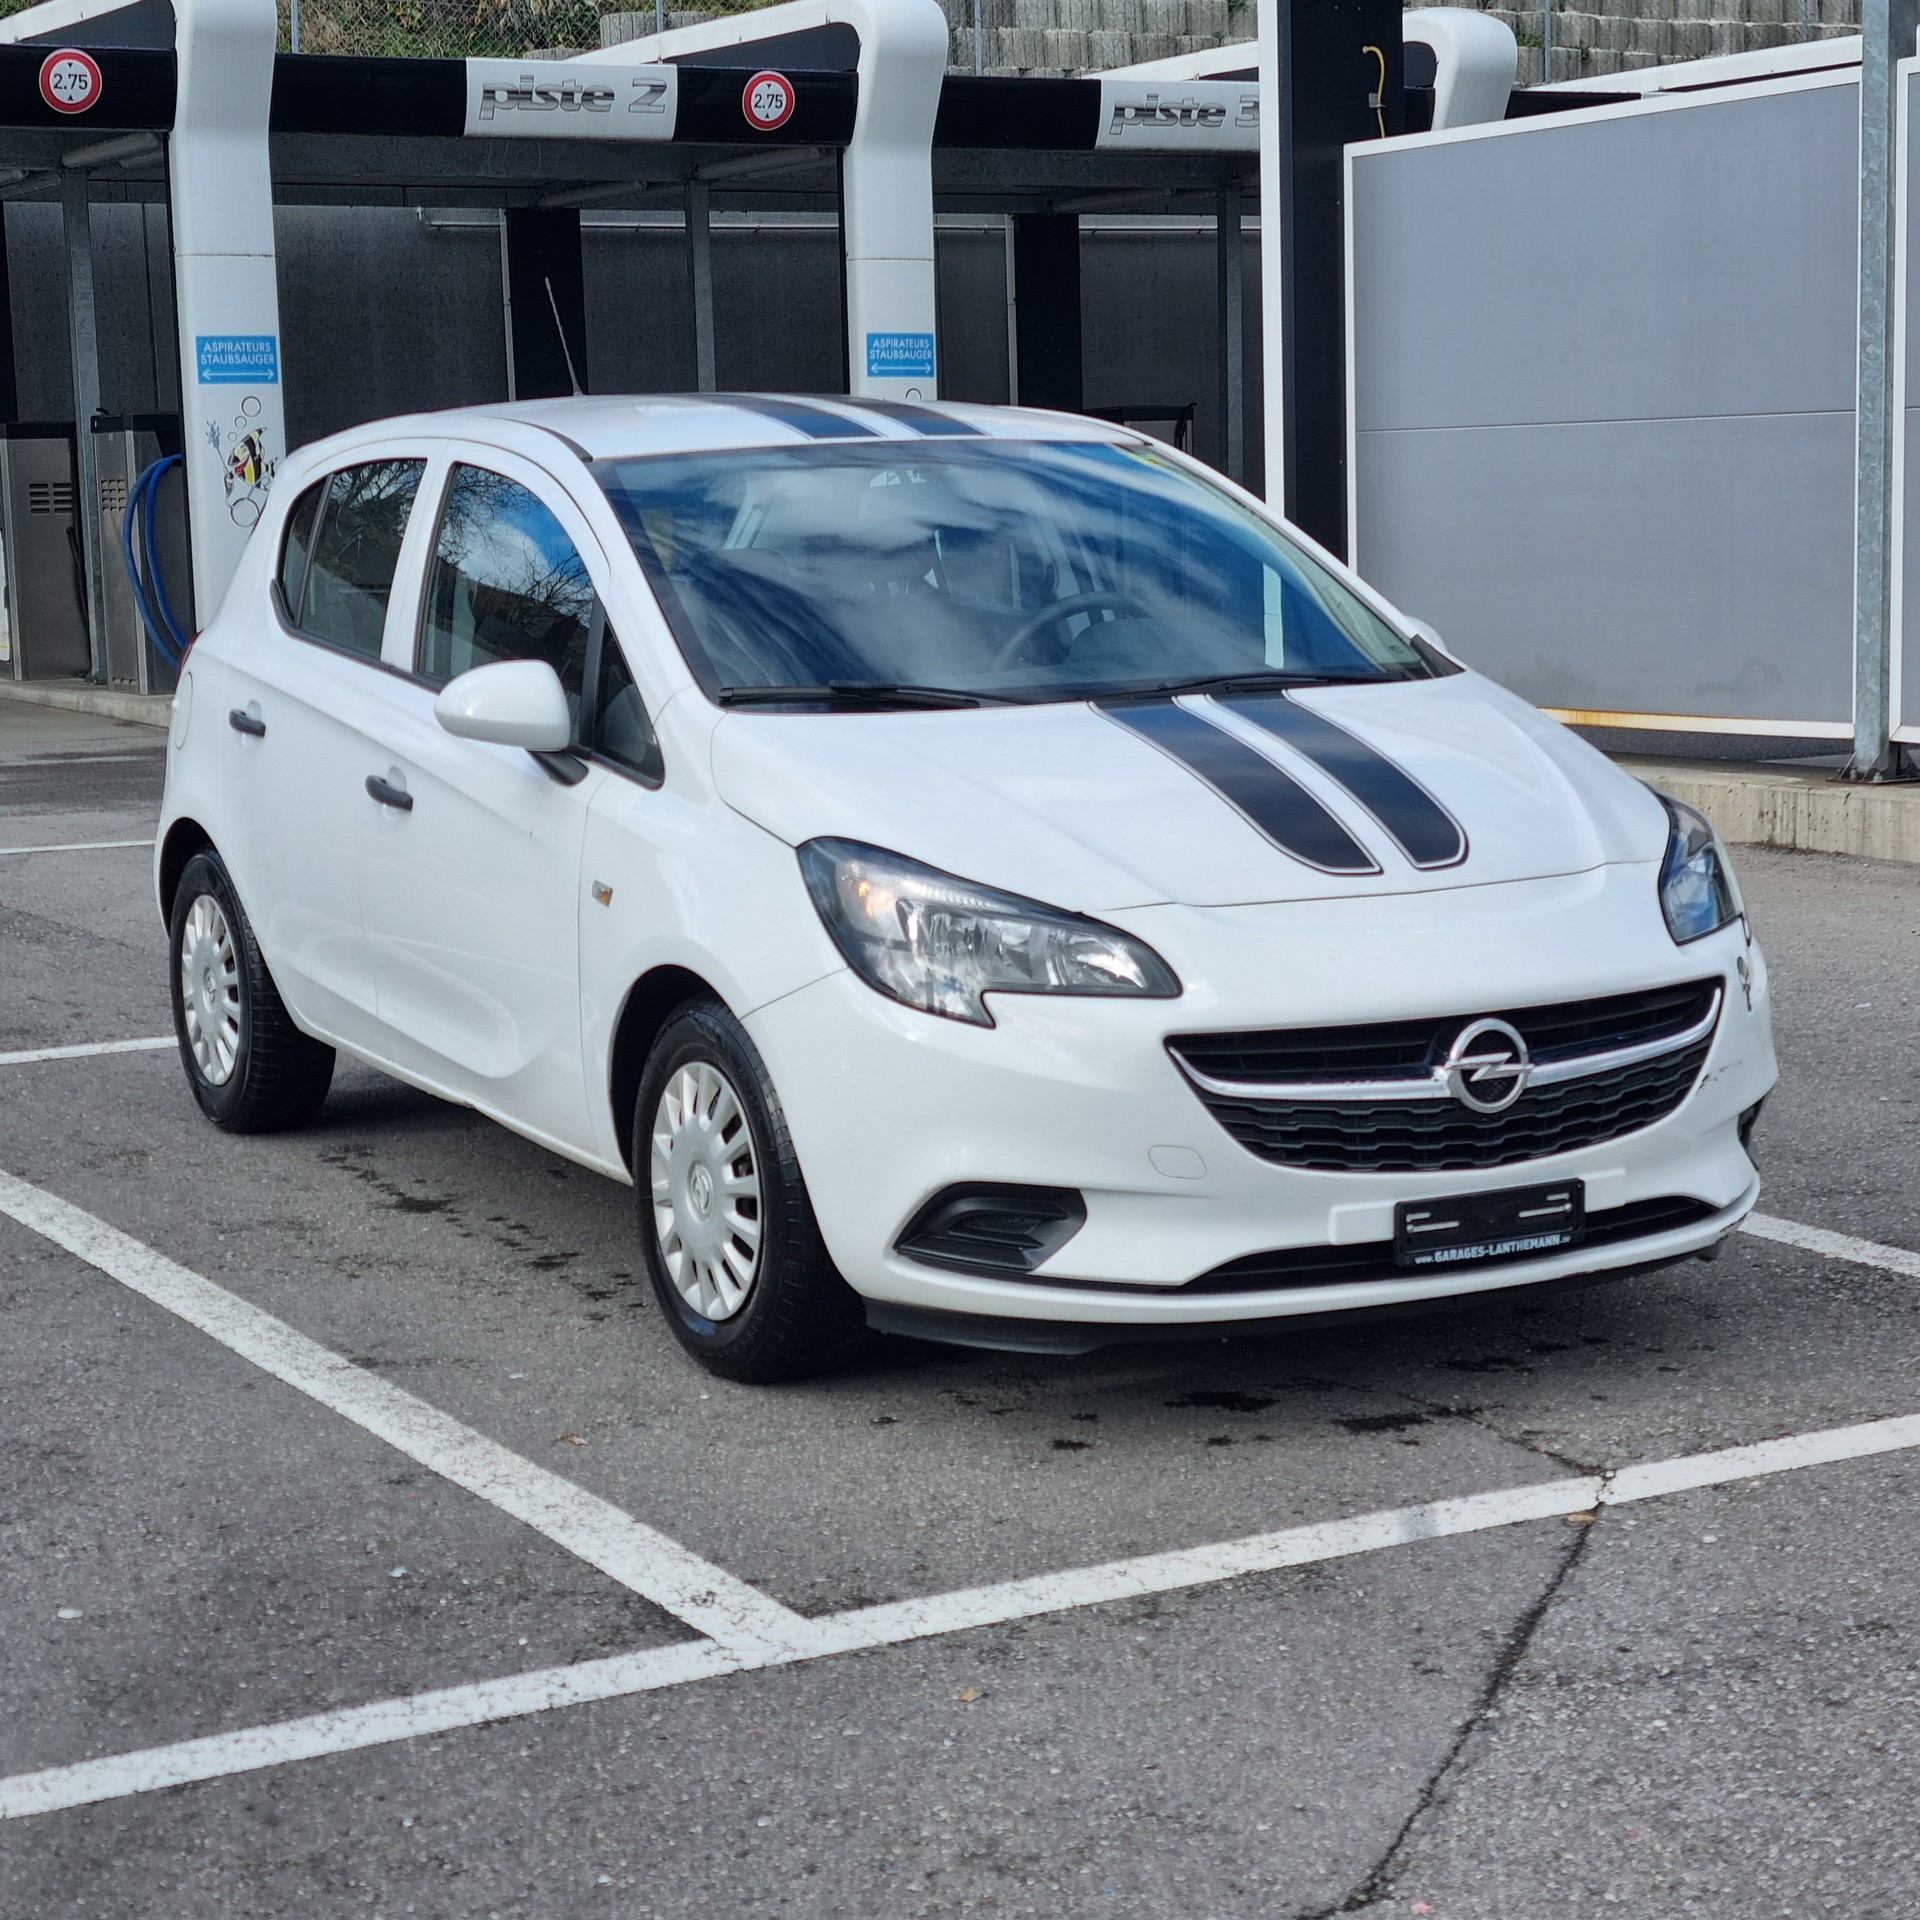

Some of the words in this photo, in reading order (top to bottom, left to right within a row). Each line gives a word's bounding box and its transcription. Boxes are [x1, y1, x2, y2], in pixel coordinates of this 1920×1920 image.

[53, 73, 88, 90] 2.75
[479, 75, 615, 121] piste
[628, 78, 667, 114] 2
[754, 93, 783, 109] 2.75
[1109, 94, 1226, 135] piste
[1235, 95, 1260, 127] 3
[203, 341, 271, 353] ASPIRATEURS
[872, 338, 930, 349] ASPIRATEURS
[201, 353, 275, 365] STAUBSAUGER
[870, 349, 932, 360] STAUBSAUGER
